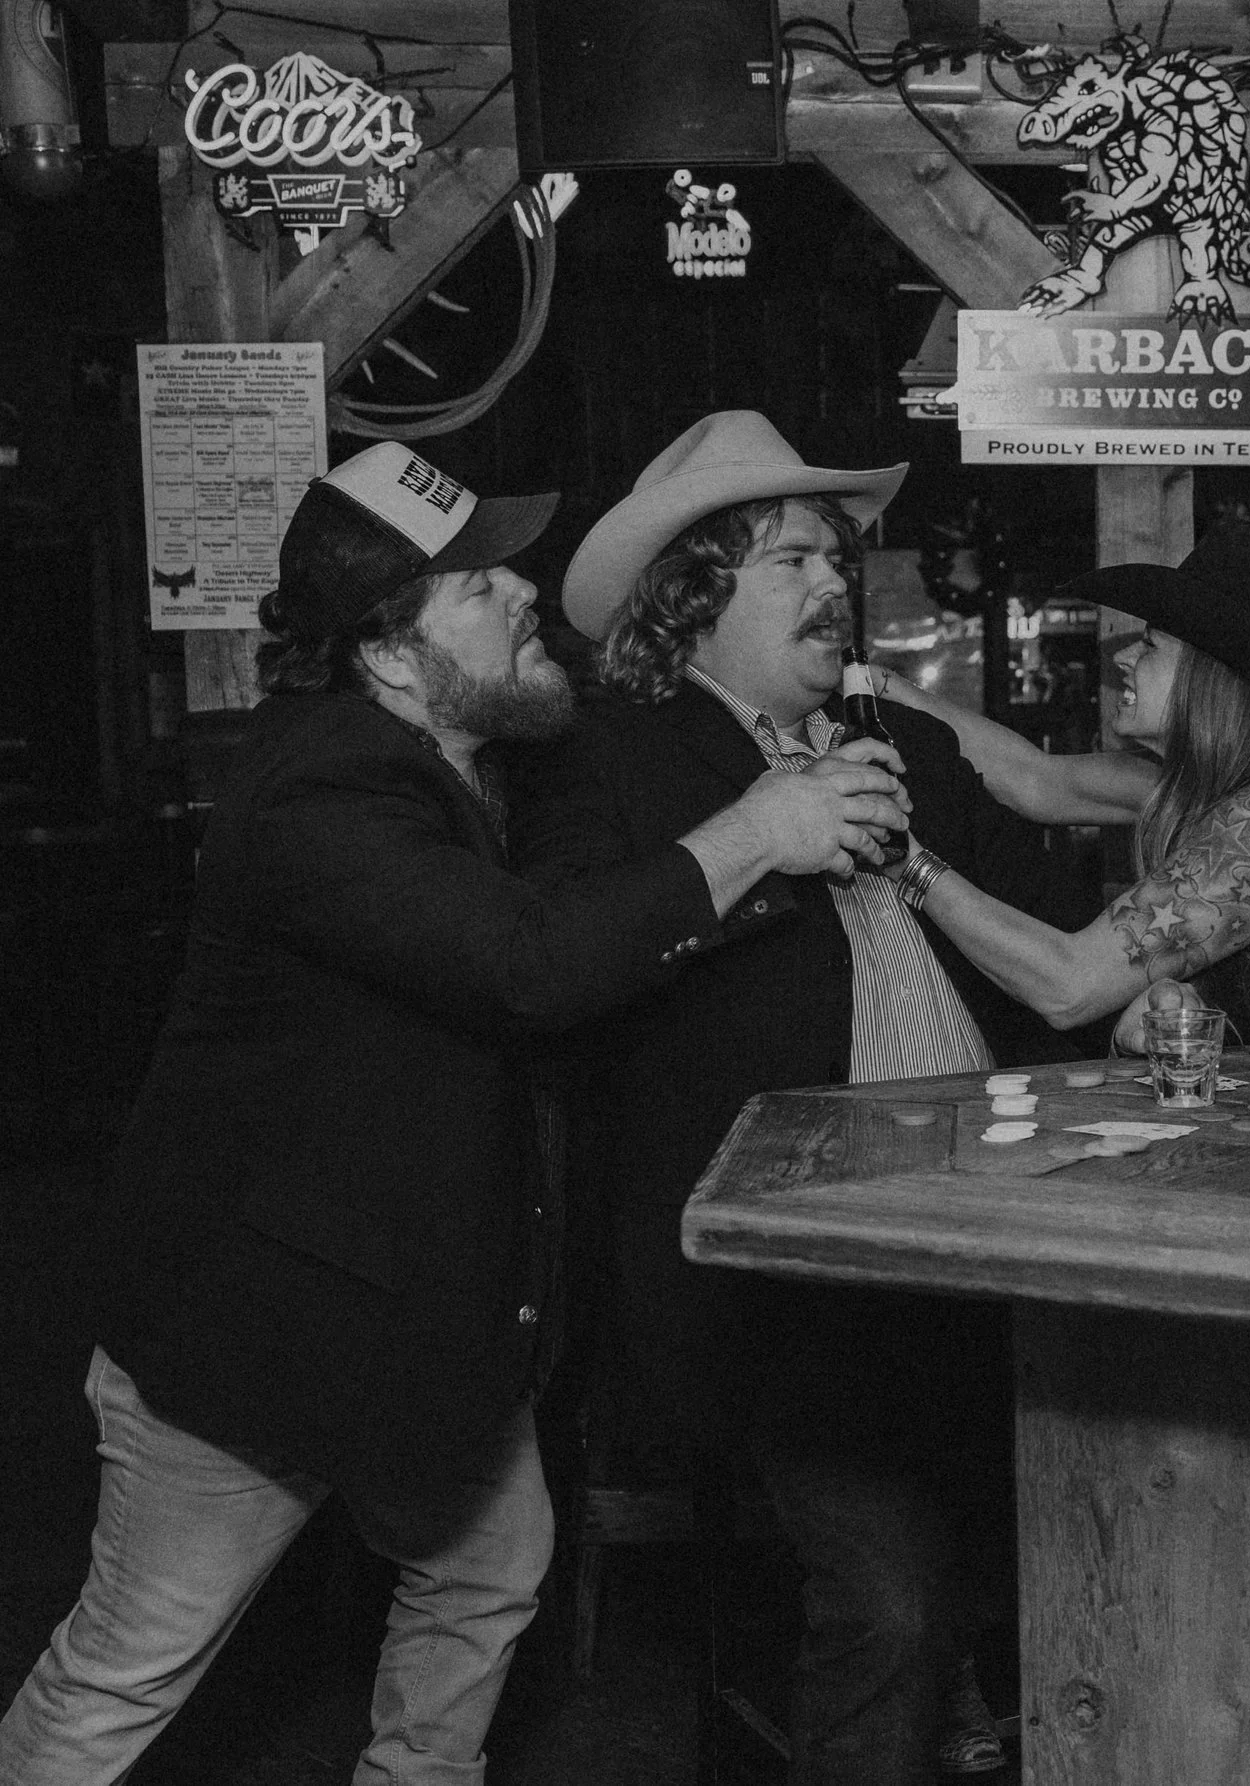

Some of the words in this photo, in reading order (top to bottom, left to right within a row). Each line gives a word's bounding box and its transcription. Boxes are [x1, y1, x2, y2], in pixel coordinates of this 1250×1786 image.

[185, 63, 416, 168] Coors
[281, 179, 336, 201] BANQUET
[665, 221, 751, 263] Modelo
[181, 349, 237, 363] January
[241, 349, 282, 361] Bands
[1036, 388, 1198, 409] BREWING
[988, 440, 1085, 456] PROUDLY
[1095, 441, 1186, 456] BREWED
[1195, 442, 1214, 456] IN
